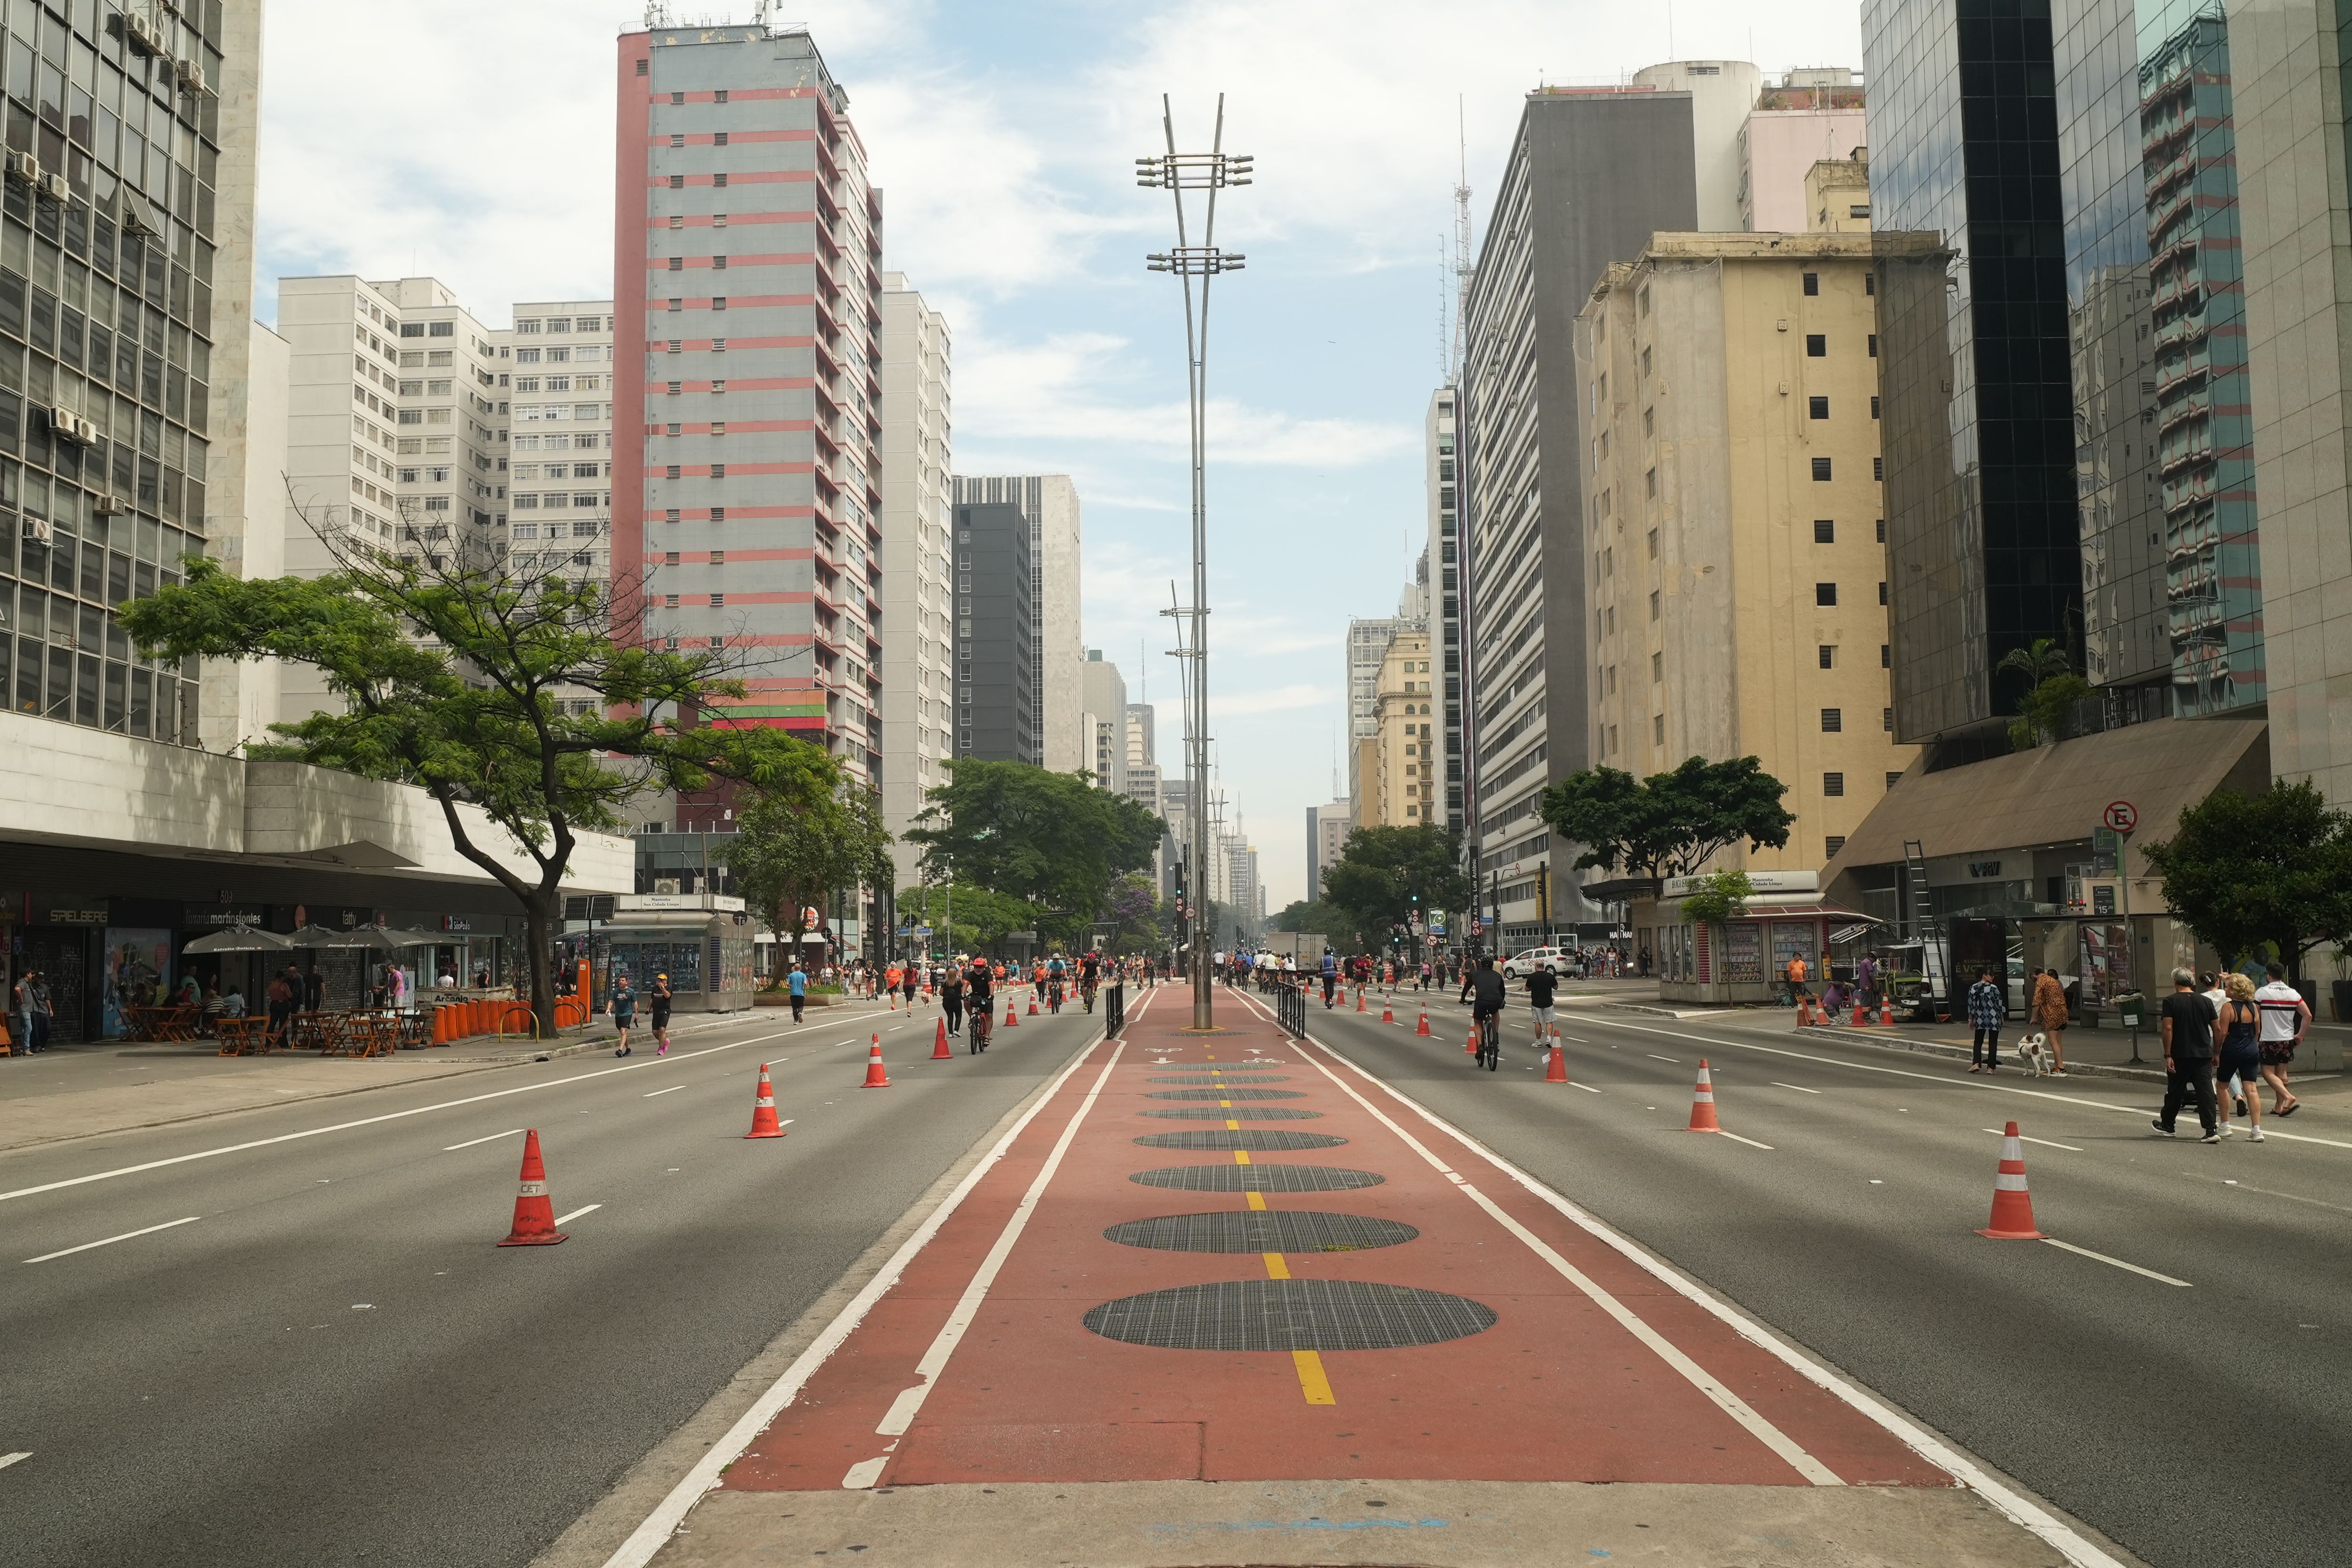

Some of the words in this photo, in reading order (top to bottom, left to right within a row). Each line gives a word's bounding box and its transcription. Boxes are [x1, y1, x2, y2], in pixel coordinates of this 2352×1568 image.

[185, 910, 210, 924] livraria
[342, 910, 357, 928] fatty
[521, 1185, 541, 1193] CET
